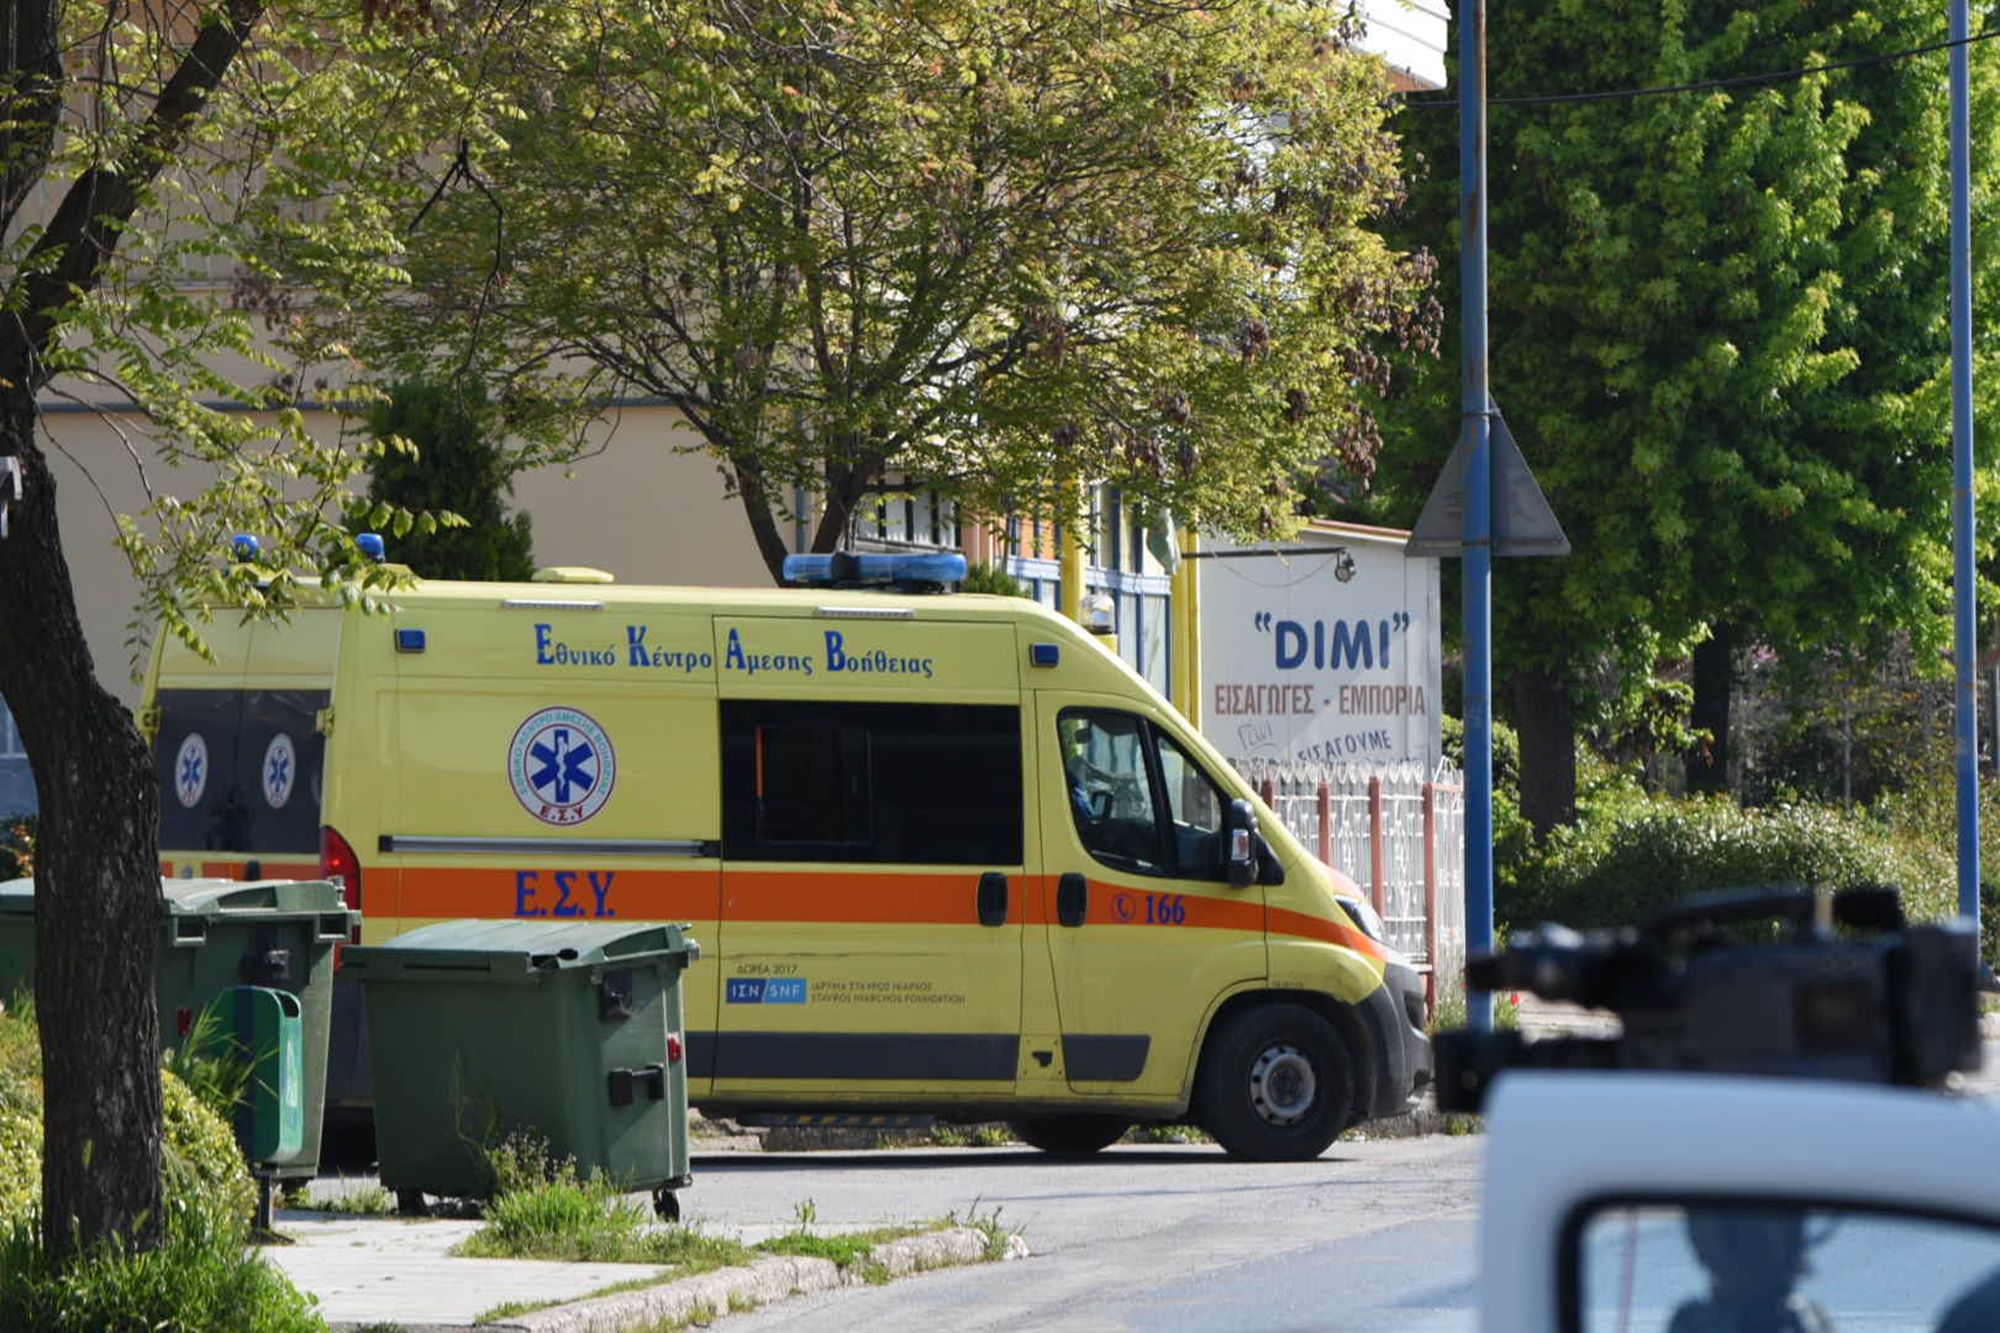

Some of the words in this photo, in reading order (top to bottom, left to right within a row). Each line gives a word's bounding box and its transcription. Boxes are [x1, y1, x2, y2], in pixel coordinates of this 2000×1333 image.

[534, 622, 616, 668] Εθνικό
[626, 625, 713, 673] Κέντρο
[725, 627, 814, 676] Αμεσης
[824, 630, 934, 679] Βοήθειας
[1215, 684, 1315, 716] ΕΙΣΑΓΩΓΕΣ
[1338, 684, 1427, 716] ΕΜΠΟΡΙΑ
[1146, 893, 1186, 925] 166
[773, 964, 798, 975] 2017
